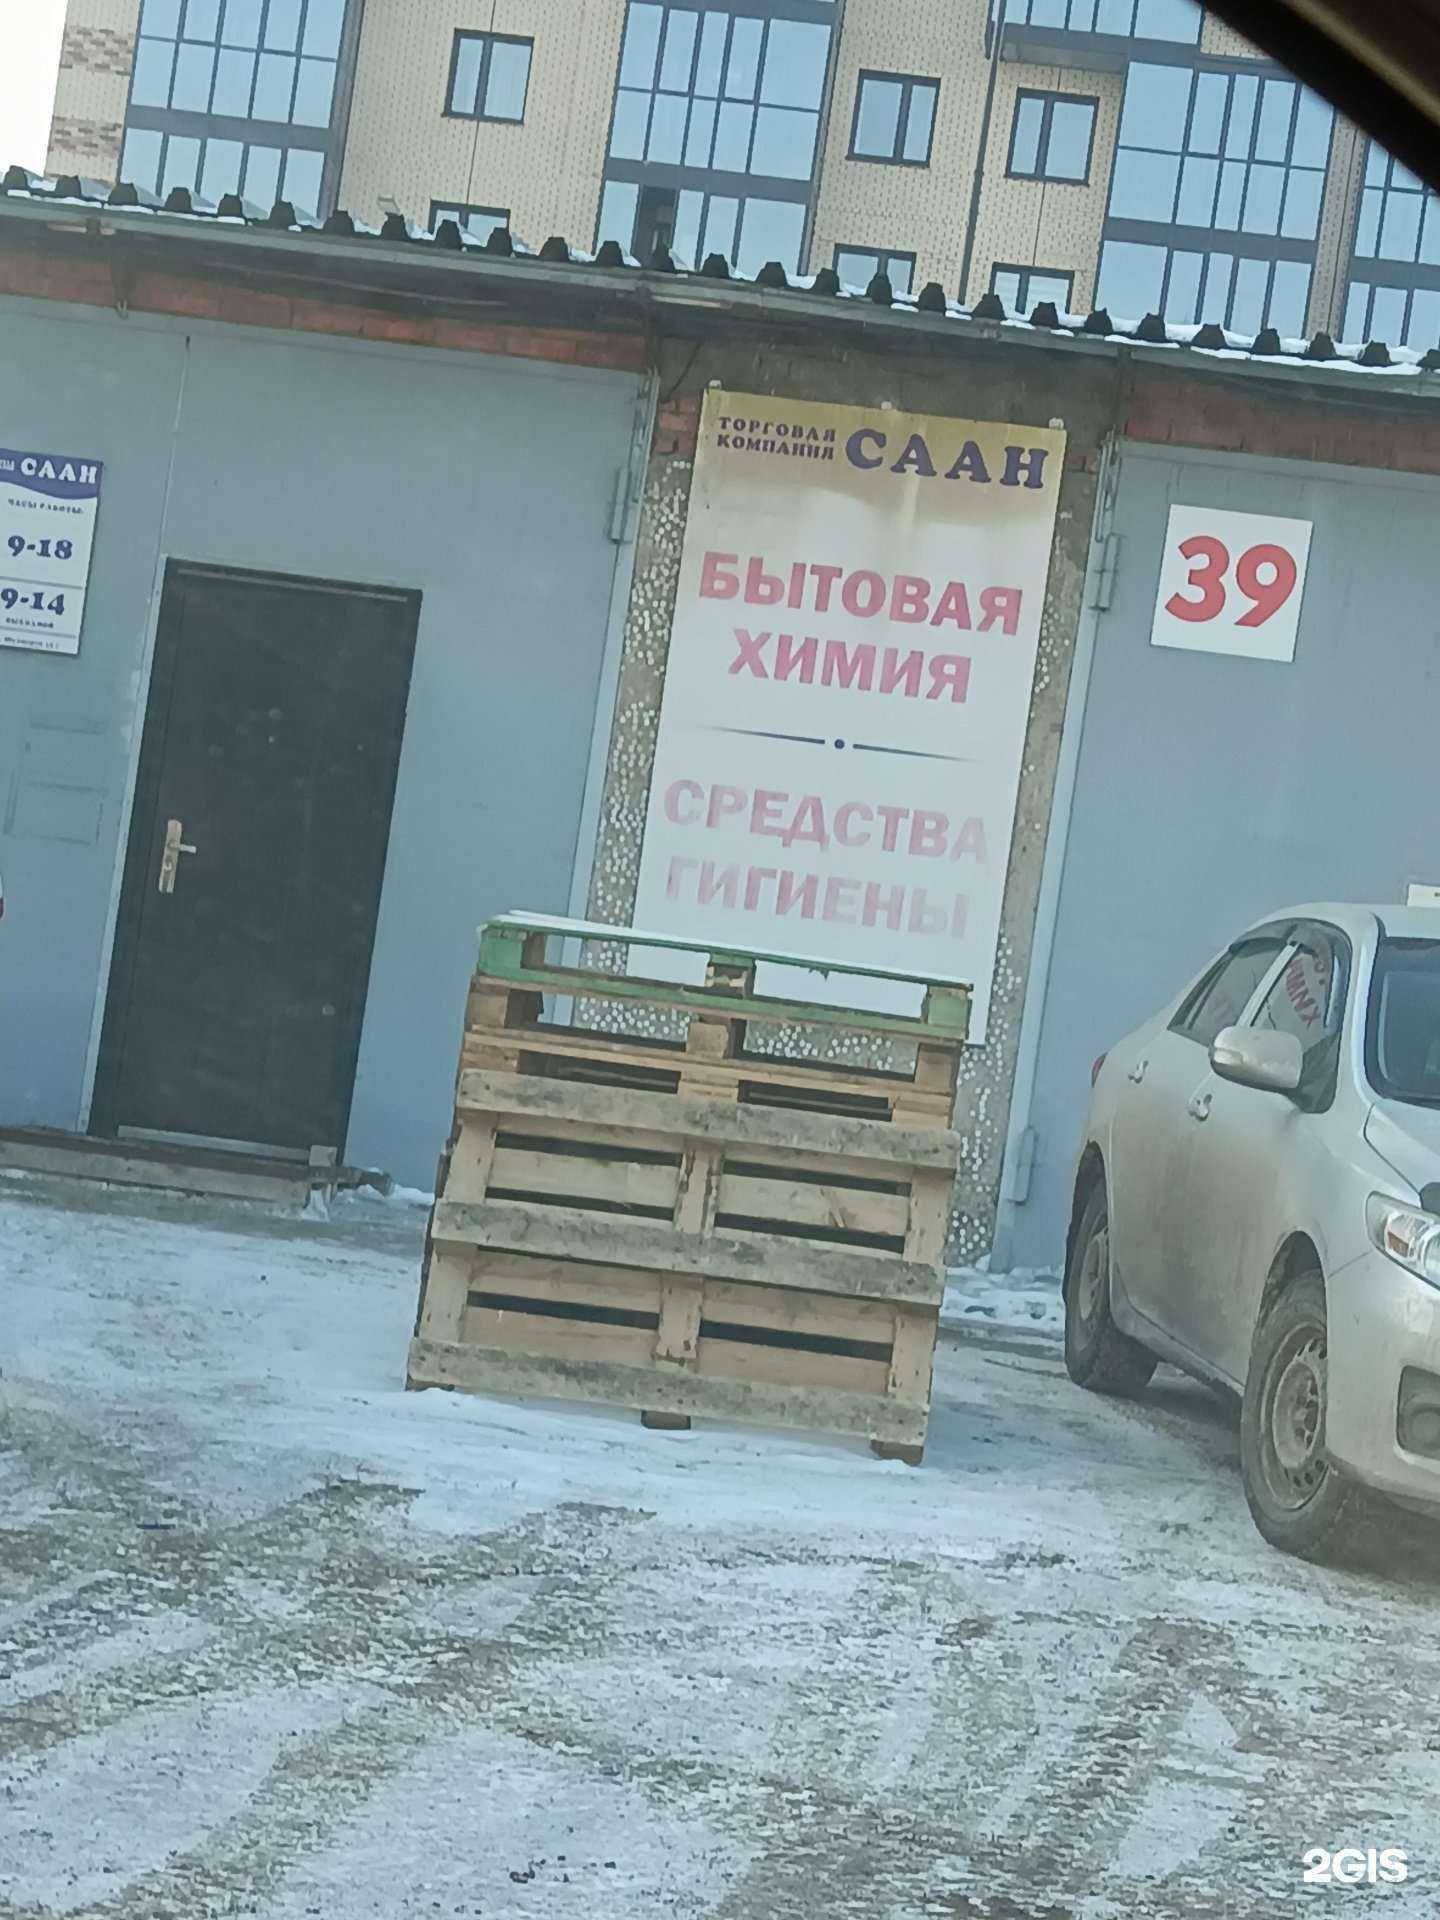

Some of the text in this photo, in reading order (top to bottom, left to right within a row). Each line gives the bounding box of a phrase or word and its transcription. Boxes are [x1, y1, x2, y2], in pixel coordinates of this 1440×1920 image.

[717, 434, 835, 461] КОМПАНИЯ
[718, 416, 836, 442] ТОРГОВАЯ
[845, 428, 1049, 489] СААН
[21, 457, 97, 484] СААН
[8, 535, 73, 559] 9-18
[1, 588, 65, 616] 9-14
[699, 551, 1023, 636] БЫТОВАЯ
[1165, 535, 1297, 628] 39
[727, 628, 972, 704] ХИМИЯ
[664, 779, 988, 865] СРЕДСТВА
[665, 855, 969, 939] ГИГИЕНЫ
